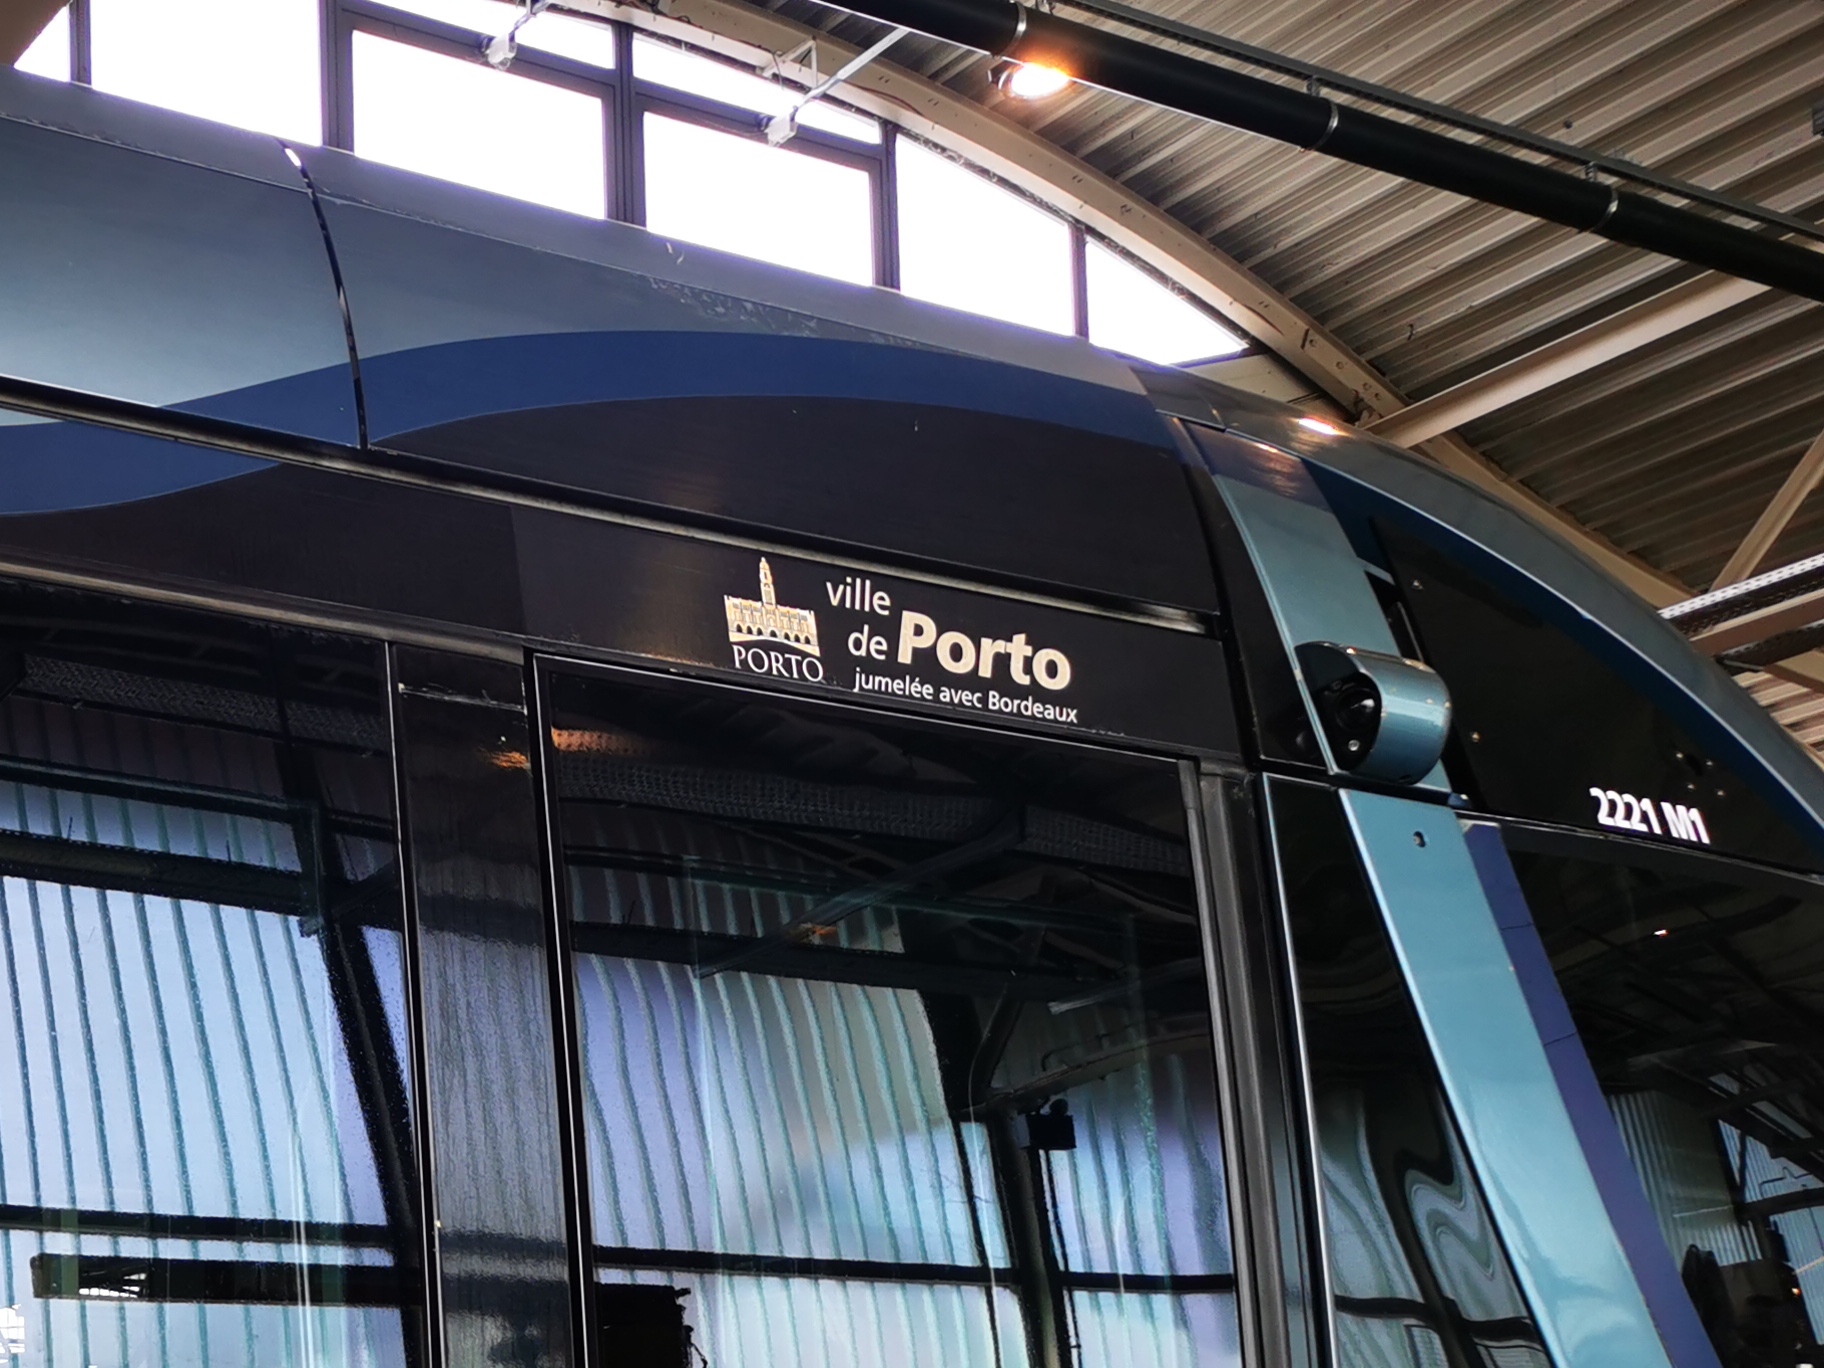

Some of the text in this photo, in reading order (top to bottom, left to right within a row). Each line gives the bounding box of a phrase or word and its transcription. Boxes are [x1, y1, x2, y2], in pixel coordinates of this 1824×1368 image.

[825, 577, 891, 616] ville
[732, 643, 824, 683] PORTO
[847, 609, 1072, 691] de Porto
[853, 667, 1078, 724] jumelée avec Bordeaux
[1589, 786, 1711, 844] 2221 M1
